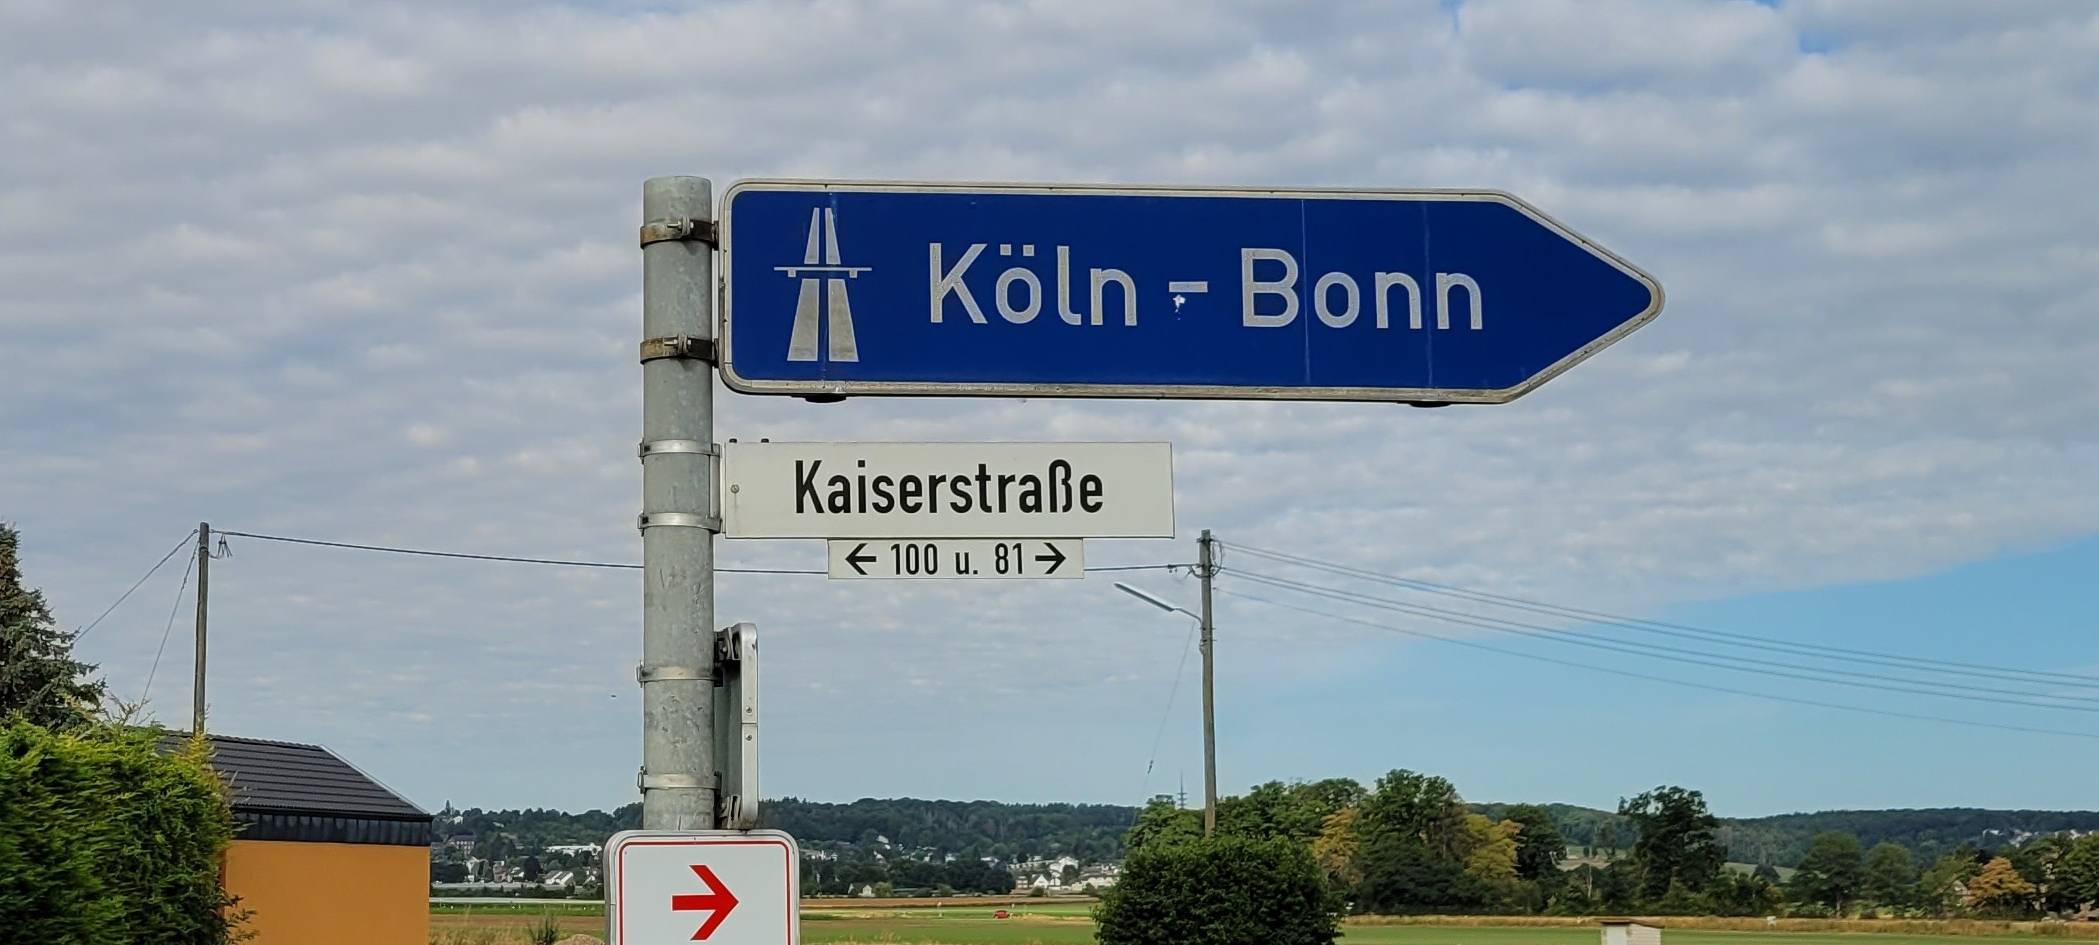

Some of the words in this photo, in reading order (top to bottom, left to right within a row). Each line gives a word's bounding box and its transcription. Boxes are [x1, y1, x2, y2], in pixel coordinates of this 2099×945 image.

[929, 242, 1138, 327] Köln
[1240, 247, 1483, 330] Bonn
[795, 459, 1104, 514] Kaiserstraße
[890, 543, 938, 576] 100
[955, 552, 979, 576] u.
[994, 542, 1023, 575] 81
